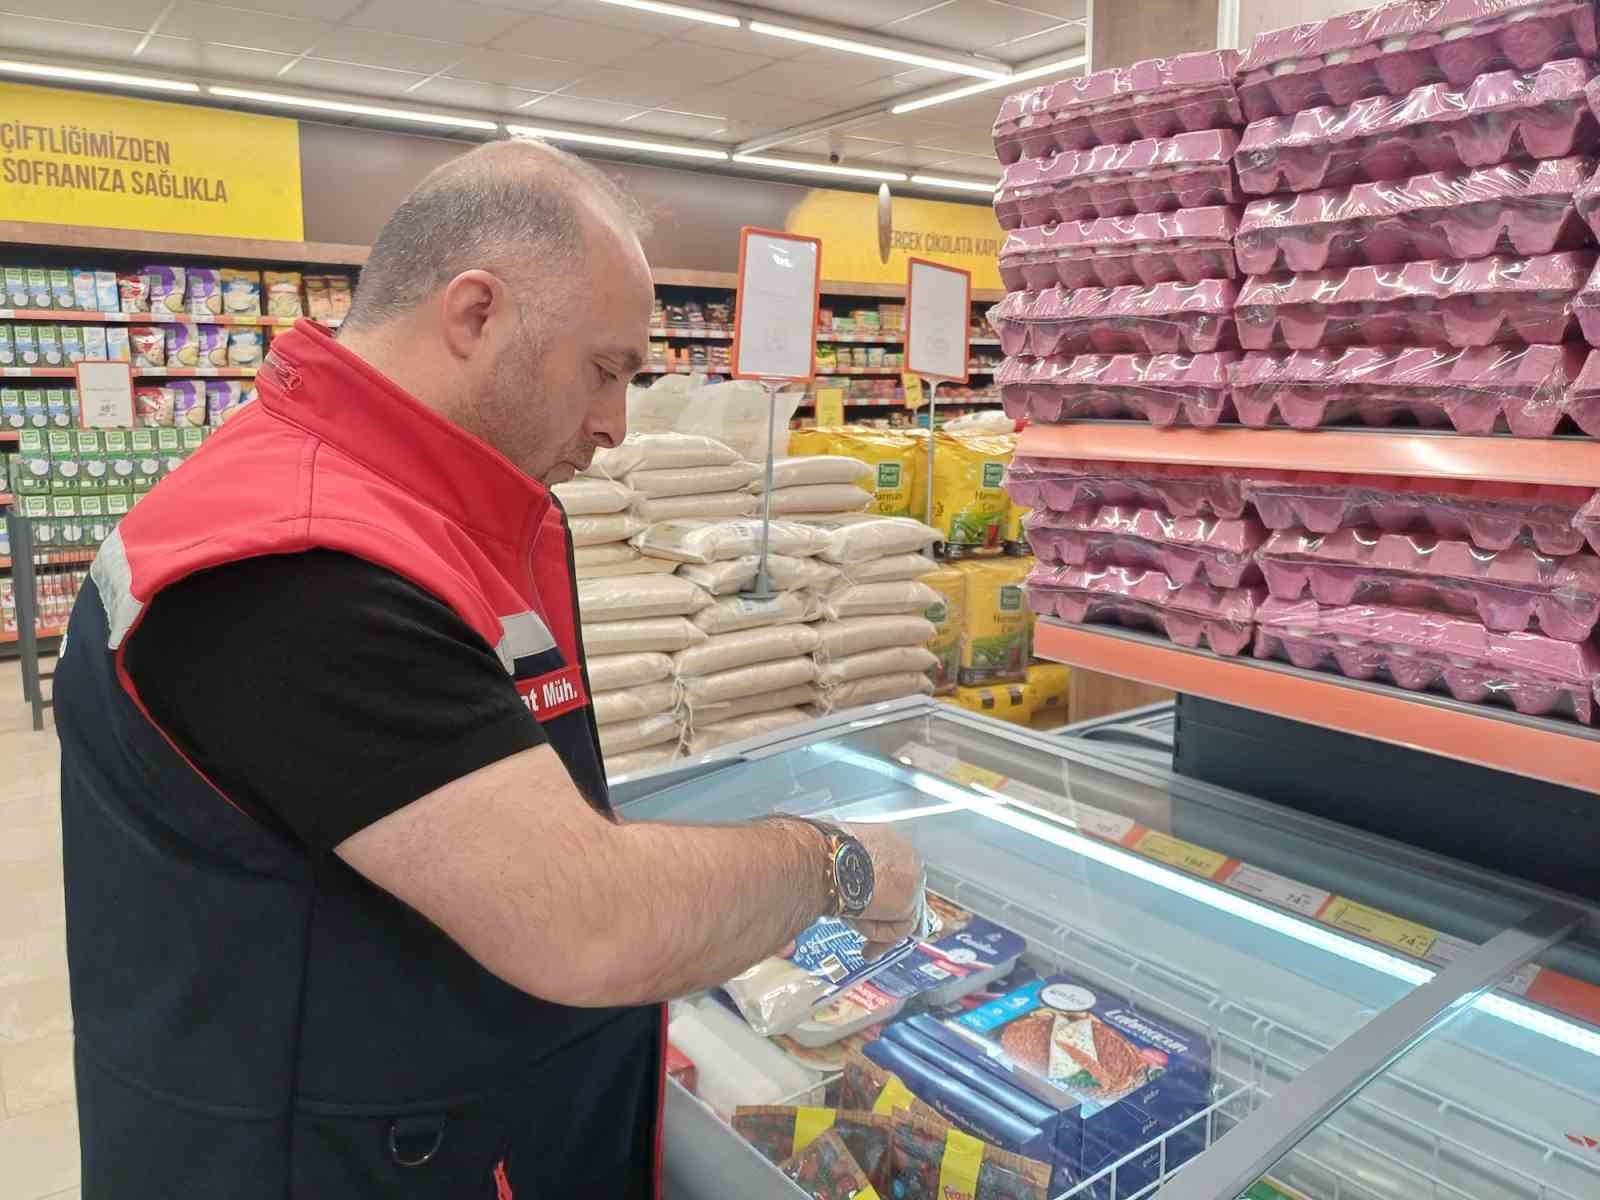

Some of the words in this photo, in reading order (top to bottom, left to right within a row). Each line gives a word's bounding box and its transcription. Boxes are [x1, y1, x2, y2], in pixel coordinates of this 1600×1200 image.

[0, 120, 171, 165] ÇİFTLİĞİMİZDEN
[2, 157, 125, 194] SOFRANIZA
[131, 169, 228, 203] SAĞLIKLA
[890, 230, 924, 253] ERÇEK
[542, 677, 578, 708] Müh.
